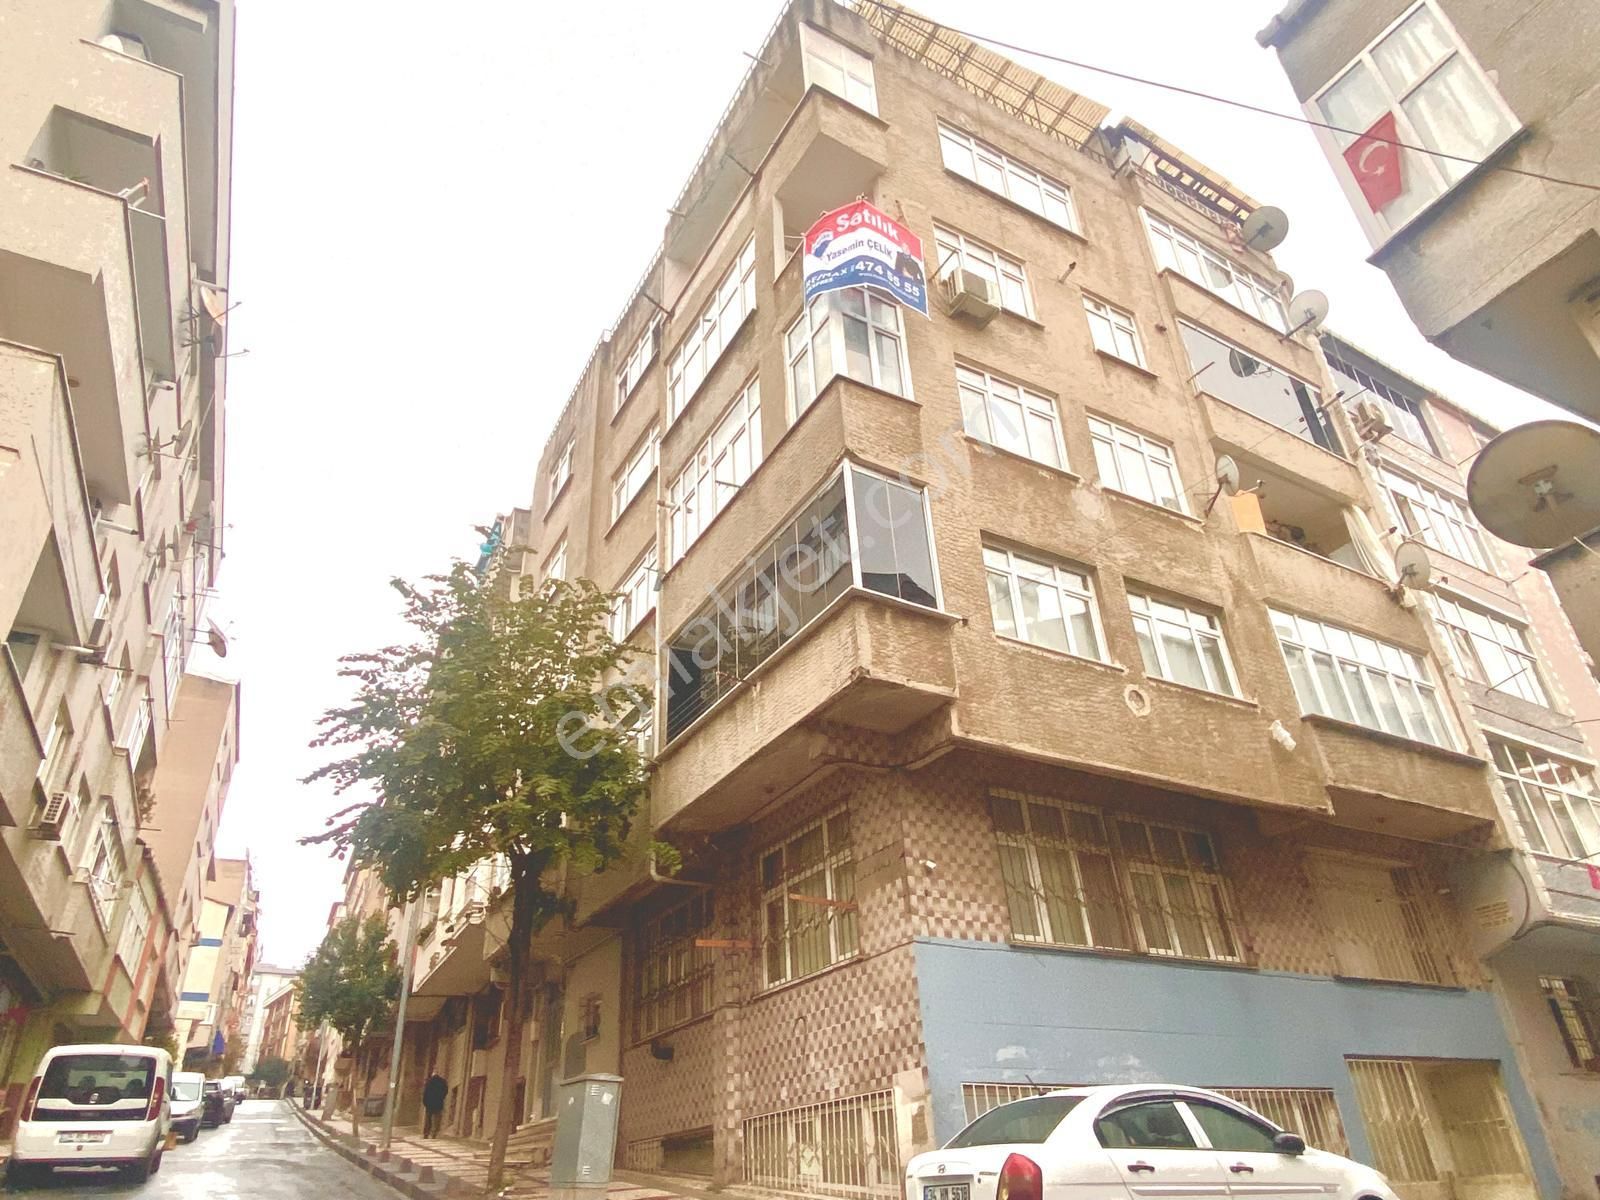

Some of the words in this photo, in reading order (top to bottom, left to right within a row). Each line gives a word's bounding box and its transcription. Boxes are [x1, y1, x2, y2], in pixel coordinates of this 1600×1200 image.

[836, 208, 899, 241] Satılık
[826, 239, 865, 262] Yasemin
[855, 260, 884, 276] 474
[886, 269, 901, 288] 55
[904, 281, 920, 297] 55
